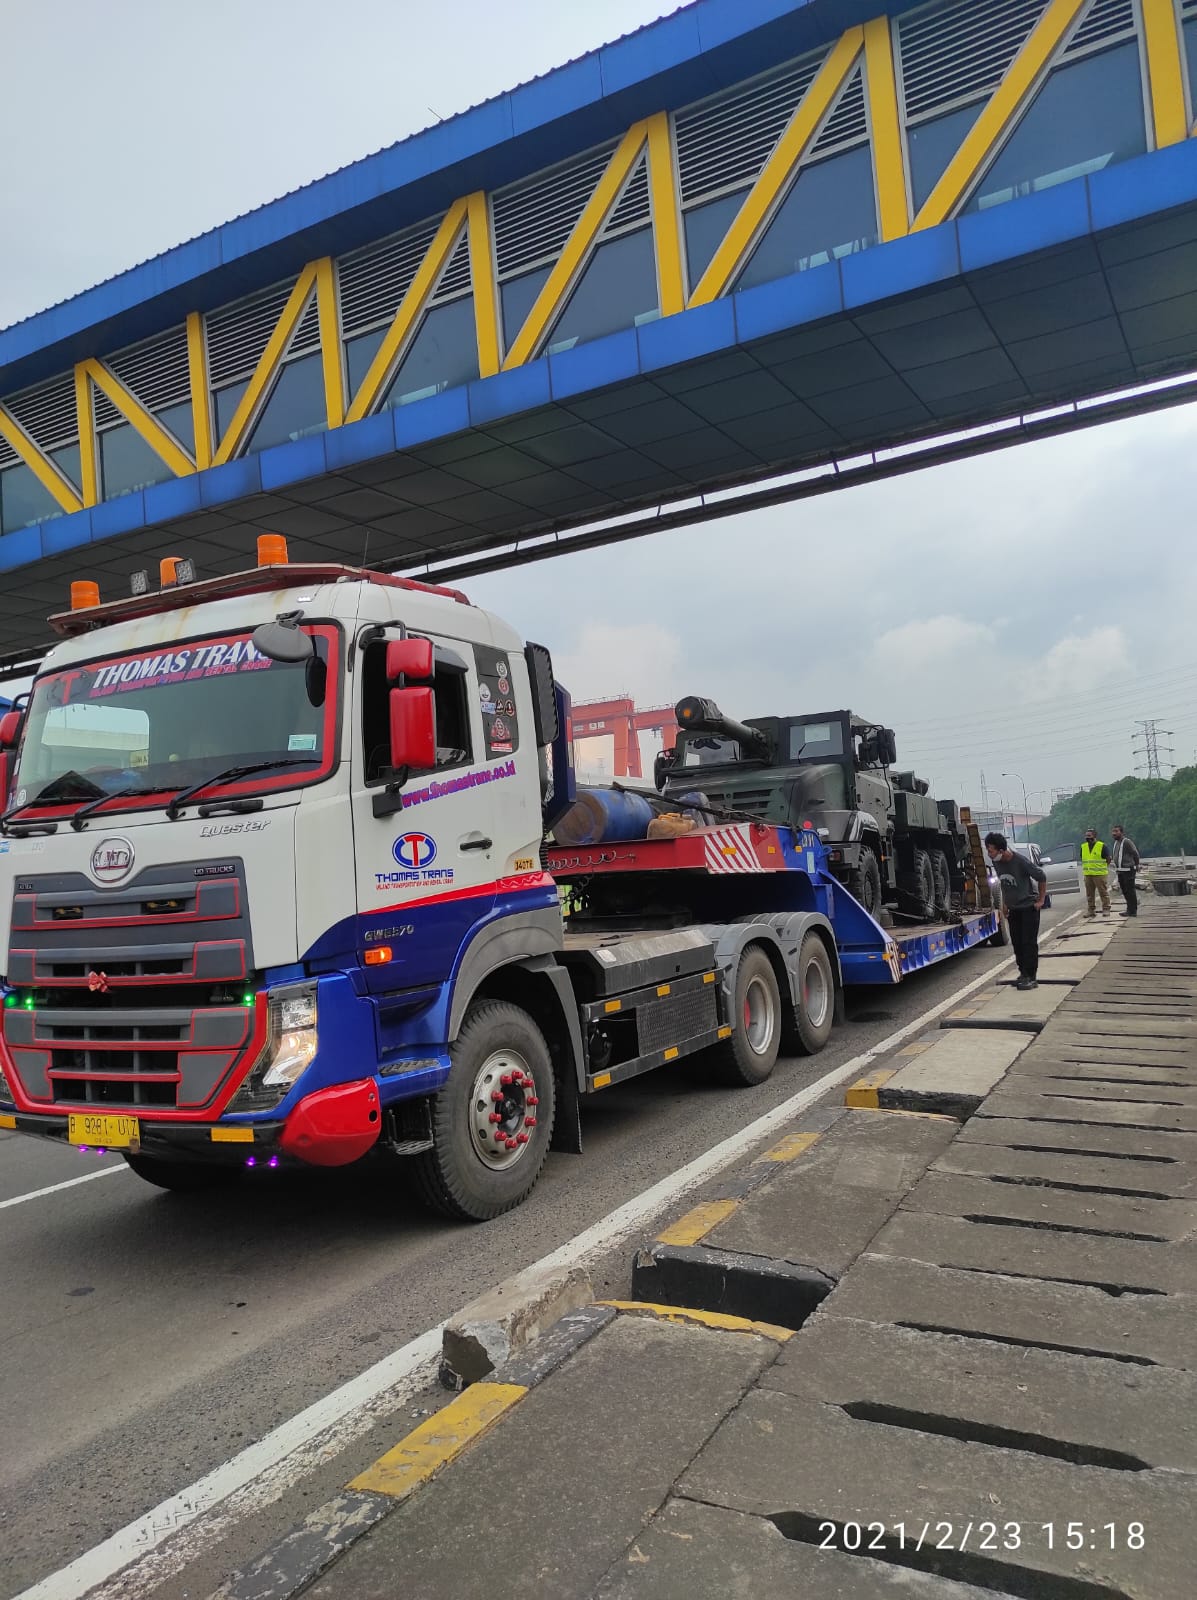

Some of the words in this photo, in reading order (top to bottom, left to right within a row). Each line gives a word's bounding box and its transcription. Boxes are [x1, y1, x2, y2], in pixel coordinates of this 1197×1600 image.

[92, 650, 189, 689] THOMAS
[200, 820, 271, 838] Quester
[206, 865, 235, 874] TRUCKS
[375, 871, 420, 883] THOMAS
[421, 869, 454, 879] TRANS
[70, 1116, 76, 1134] B
